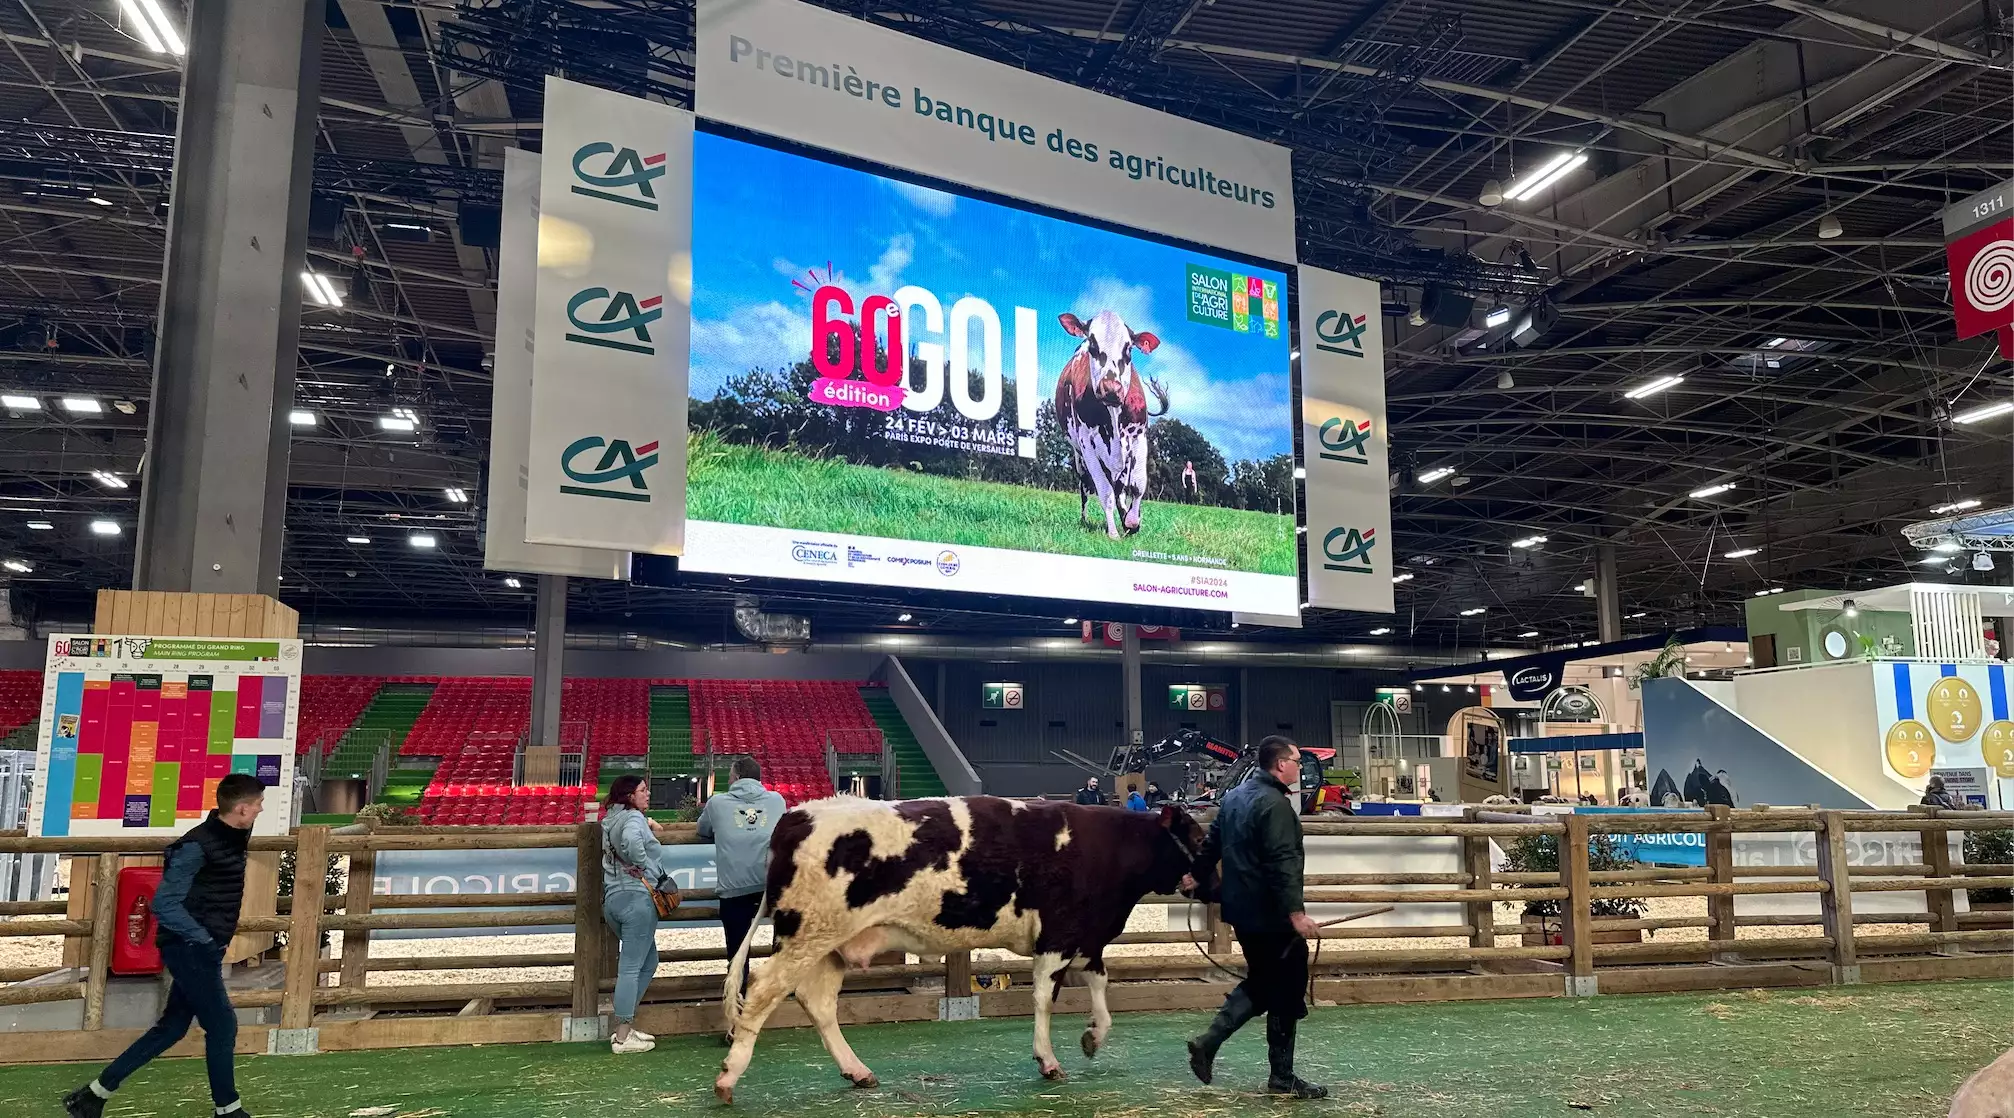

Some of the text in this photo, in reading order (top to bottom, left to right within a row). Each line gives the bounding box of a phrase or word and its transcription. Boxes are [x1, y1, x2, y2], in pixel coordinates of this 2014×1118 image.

[729, 34, 1276, 210] Première banque des agriculteurs
[1972, 195, 2004, 218] 1311
[1191, 272, 1228, 292] SALON
[1192, 304, 1229, 321] CULTURE
[823, 383, 891, 408] édition
[885, 416, 905, 430] 24
[908, 416, 936, 436] FÉV
[951, 425, 969, 440] 03
[972, 428, 1015, 447] MARS
[884, 432, 1016, 456] PARIS EXPO PORTE DE VERSAILLES
[887, 556, 932, 566] COMEXPOSIUM
[1190, 575, 1228, 587] #SIA2024
[1133, 583, 1228, 598] SALON-AGRICULTURE.COM
[1515, 674, 1548, 684] LACTALIS
[1633, 832, 1706, 848] AGRICOL
